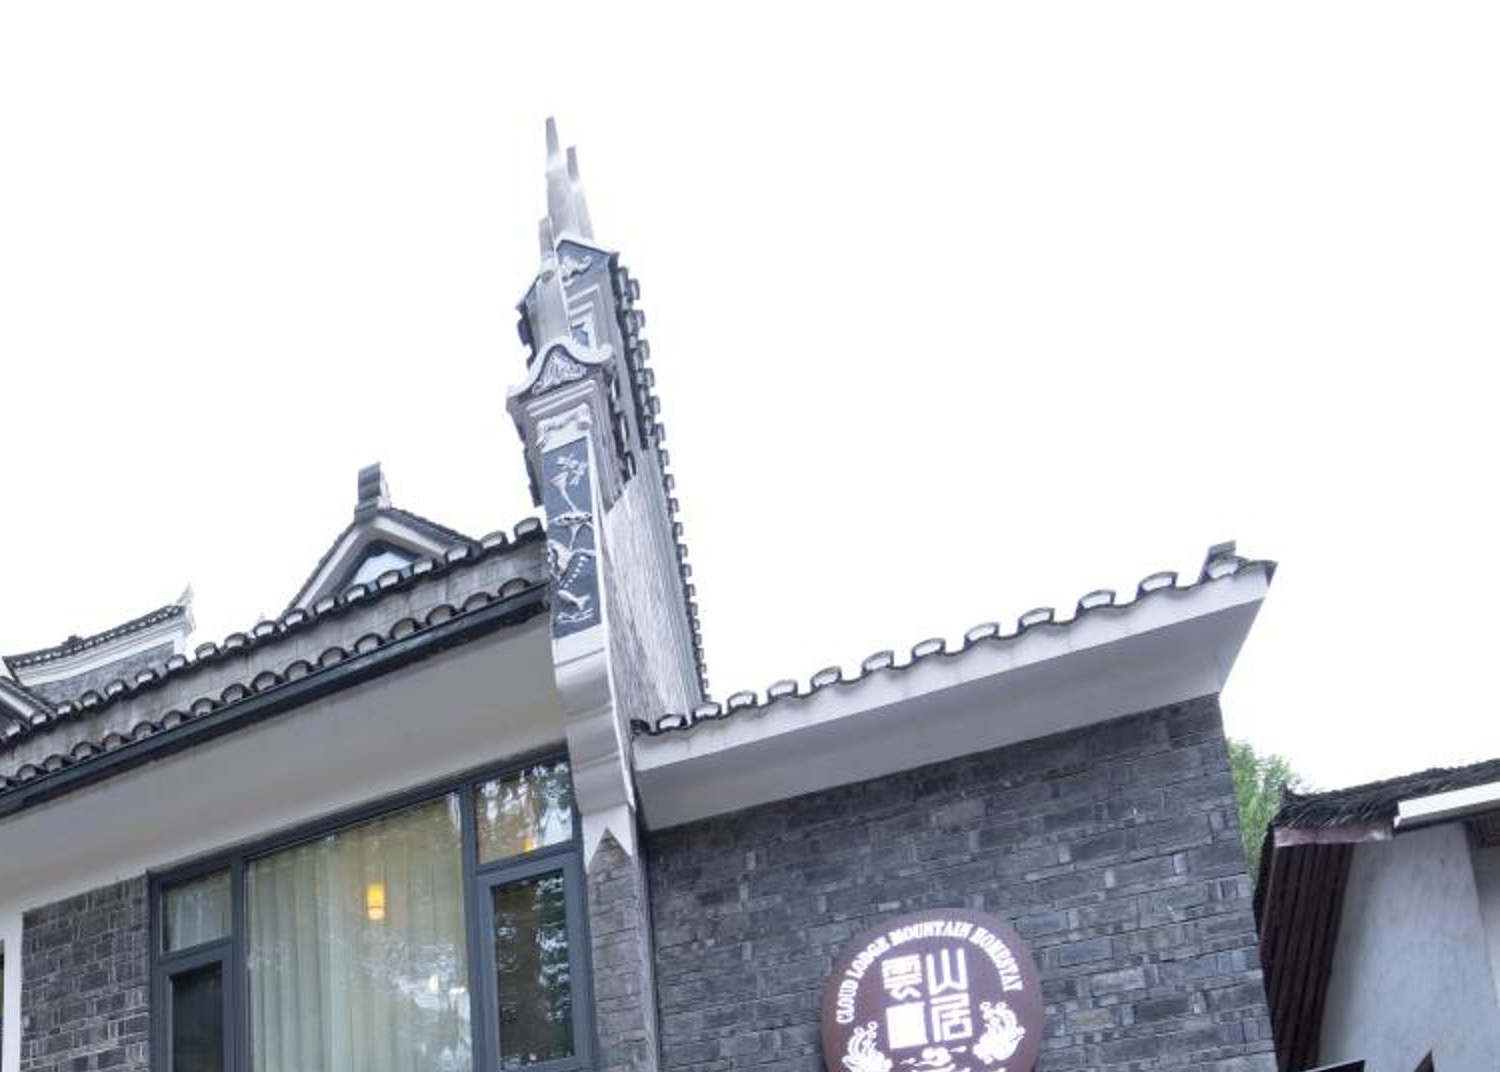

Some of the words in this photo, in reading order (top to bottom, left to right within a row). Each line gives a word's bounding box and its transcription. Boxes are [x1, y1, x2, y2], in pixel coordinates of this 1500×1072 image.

[836, 980, 859, 1024] CLOUD
[888, 920, 975, 946] MOUNTAIN
[968, 927, 1023, 992] HOMESTAY
